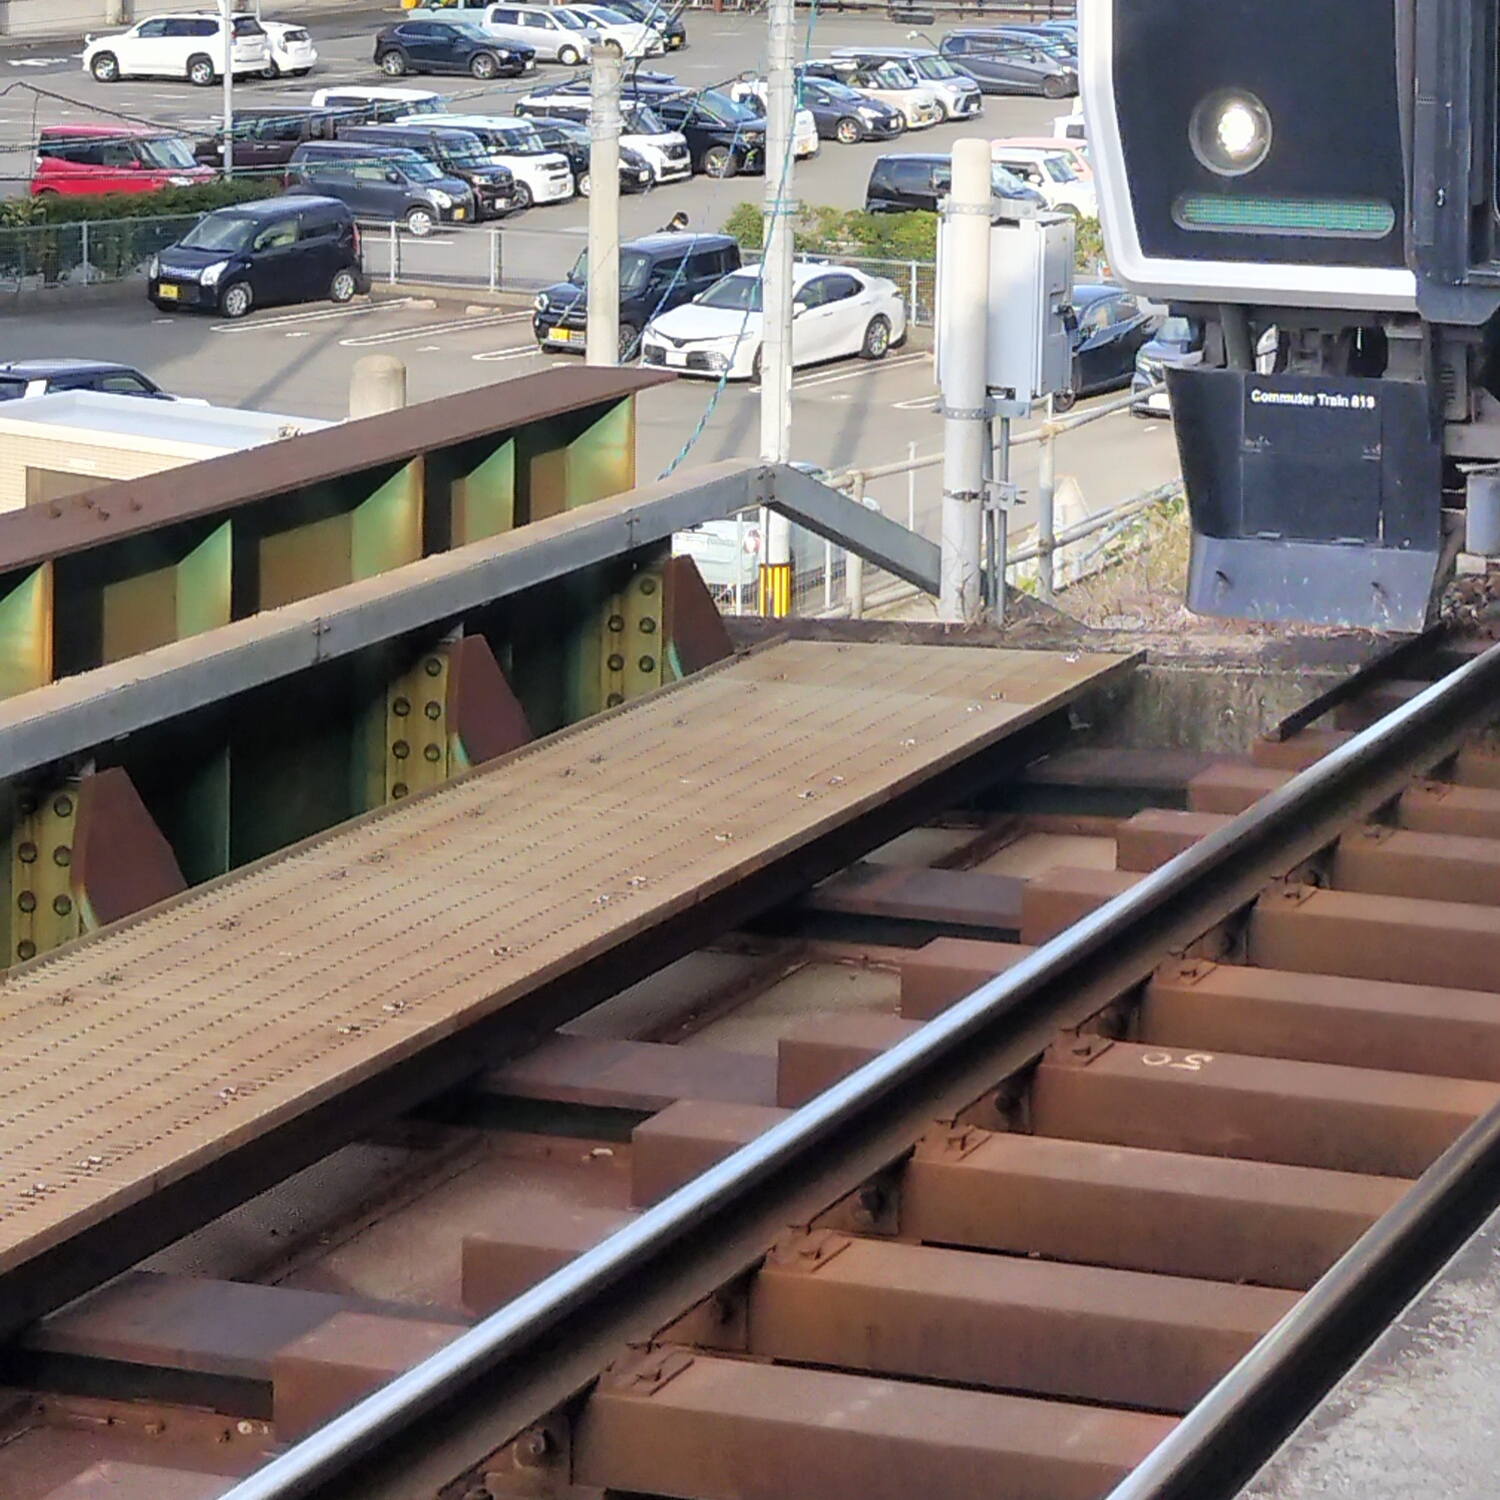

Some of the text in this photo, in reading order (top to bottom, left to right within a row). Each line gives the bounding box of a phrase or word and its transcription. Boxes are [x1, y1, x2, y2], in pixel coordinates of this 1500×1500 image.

[1251, 389, 1376, 409] Commuter Train 819
